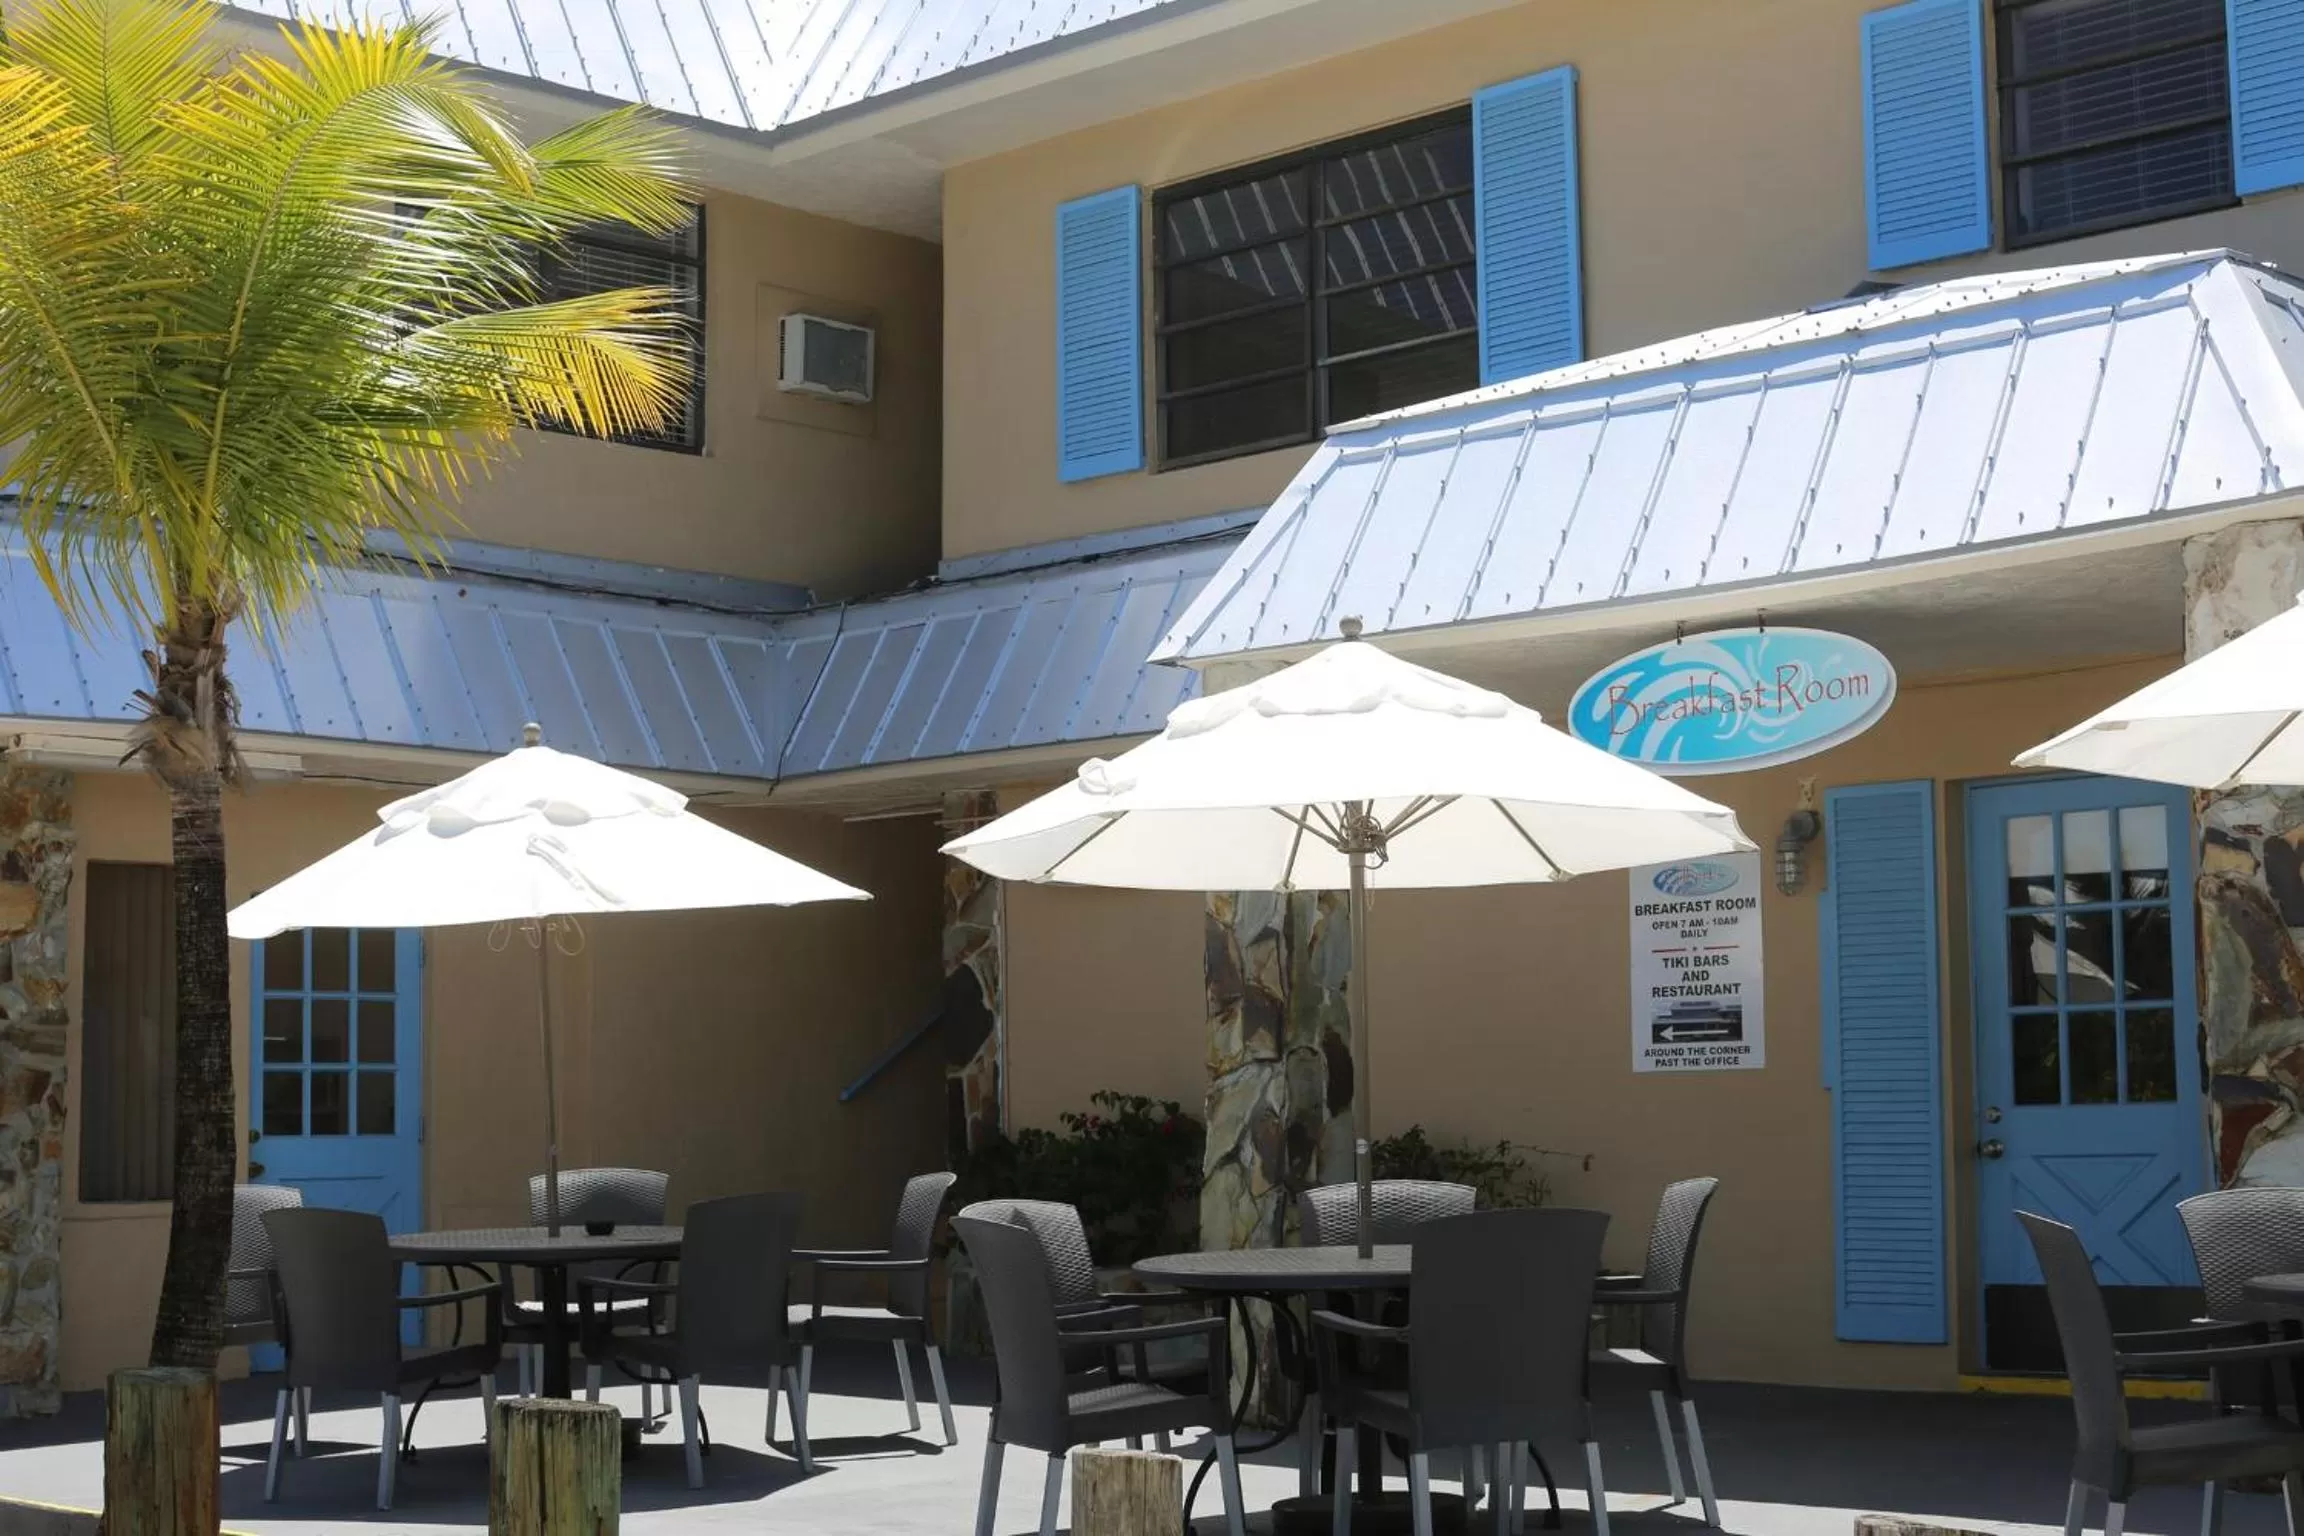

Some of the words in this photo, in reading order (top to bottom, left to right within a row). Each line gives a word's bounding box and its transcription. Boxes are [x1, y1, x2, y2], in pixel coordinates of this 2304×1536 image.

[1608, 671, 1767, 736] Breakfast
[1776, 663, 1870, 714] Room
[1635, 900, 1712, 917] BREAKFAST
[1716, 897, 1757, 911] ROOM
[1652, 920, 1679, 931] OPEN
[1681, 919, 1686, 929] 7
[1689, 918, 1704, 928] AM
[1713, 916, 1739, 926] 10AM
[1681, 928, 1709, 939] DAILY
[1663, 956, 1689, 969] TIKI
[1693, 954, 1730, 967] BARS
[1682, 970, 1710, 982] AND
[1652, 983, 1741, 998] RESTAURANT
[1644, 1047, 1685, 1057] AROUND
[1687, 1047, 1707, 1056] THE
[1709, 1046, 1751, 1055] CORNER
[1655, 1058, 1678, 1068] PAST
[1682, 1057, 1701, 1067] THE
[1704, 1056, 1740, 1066] OFFICE
